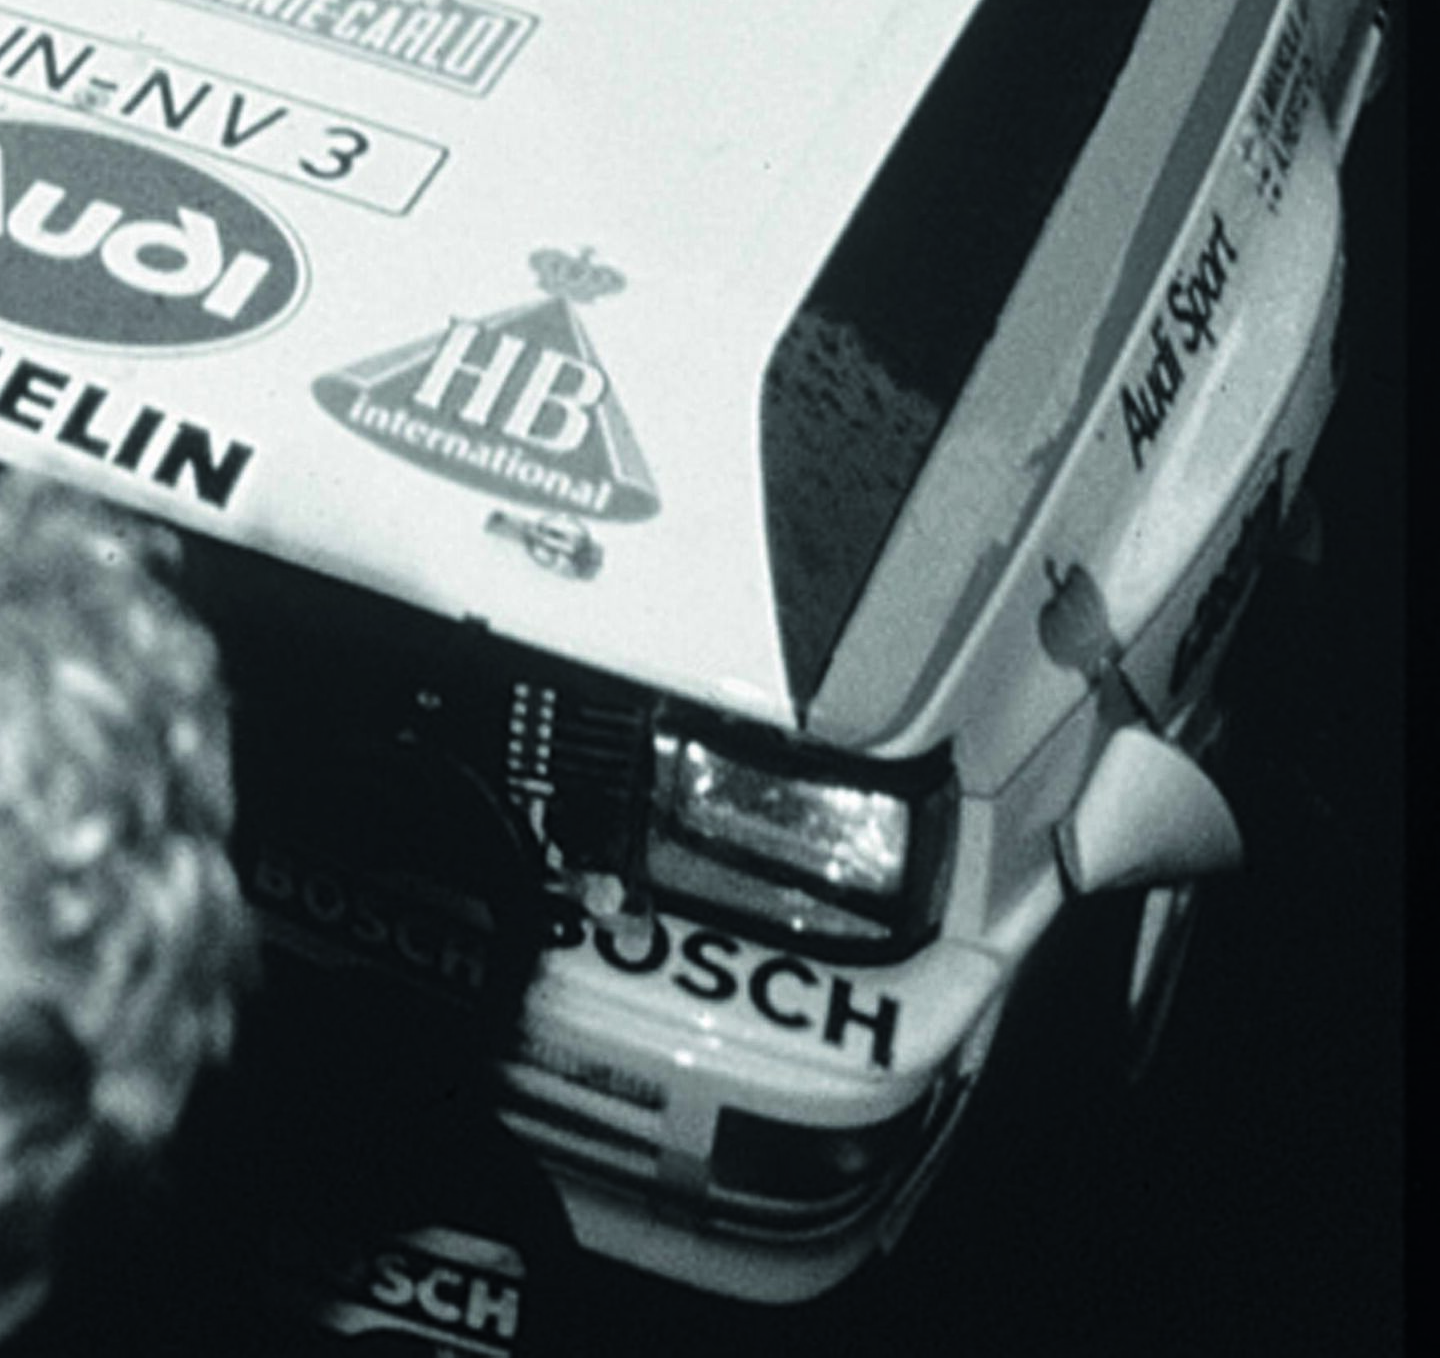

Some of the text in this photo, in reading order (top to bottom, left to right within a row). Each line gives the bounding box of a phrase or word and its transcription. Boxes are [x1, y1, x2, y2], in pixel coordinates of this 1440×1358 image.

[300, 125, 371, 181] 3
[412, 317, 607, 453] HB
[1117, 211, 1240, 472] Audi Sport
[253, 845, 486, 989] BOSCH
[371, 1252, 520, 1338] SCH
